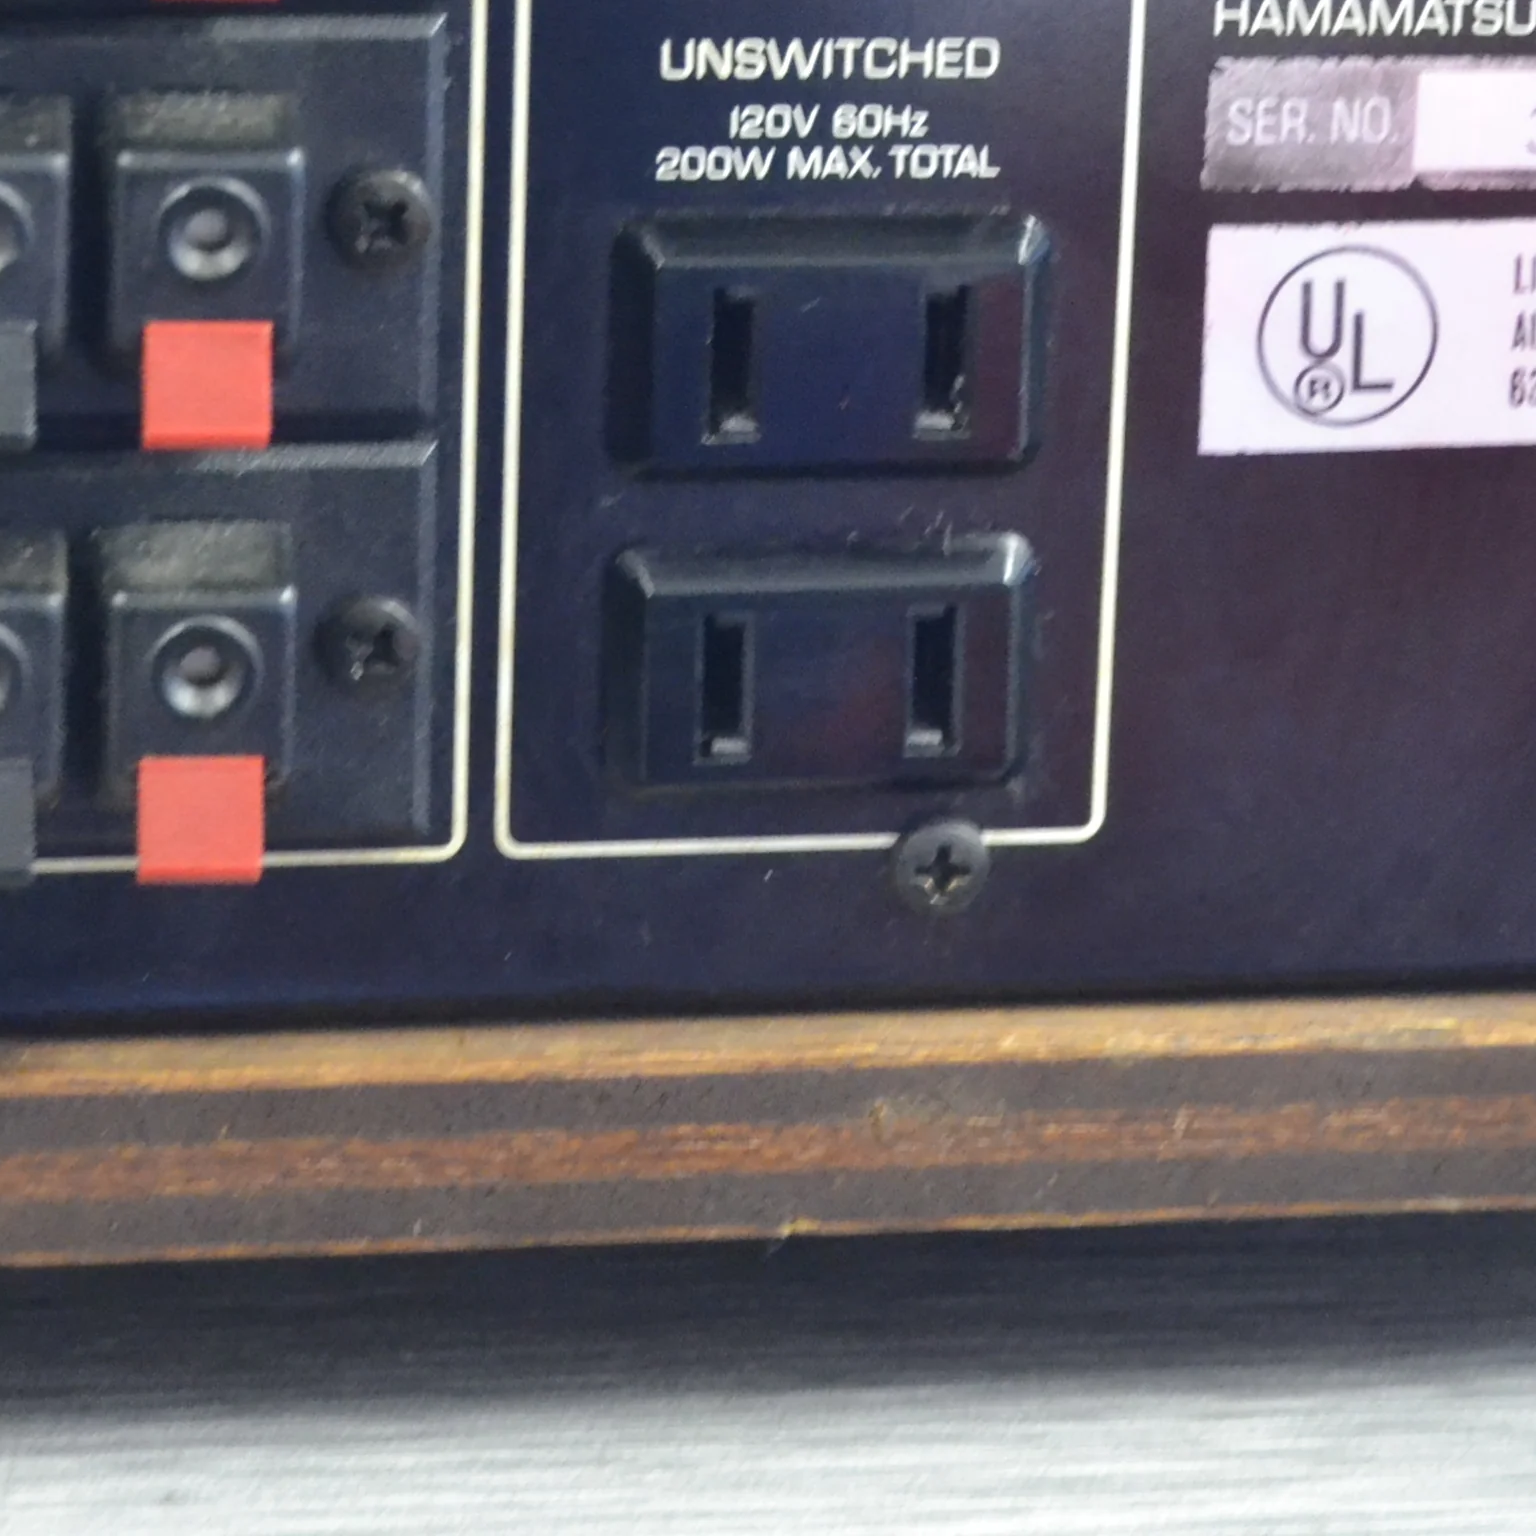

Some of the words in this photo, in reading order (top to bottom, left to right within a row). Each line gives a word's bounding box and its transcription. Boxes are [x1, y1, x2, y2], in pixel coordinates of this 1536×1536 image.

[661, 37, 1000, 80] UNSWITCHED
[730, 104, 820, 138] 120V
[832, 104, 929, 138] 60Hz
[1227, 99, 1316, 146] SER.
[1330, 94, 1398, 144] NO.
[656, 146, 775, 180] 200W
[889, 144, 1000, 178] TOTAL
